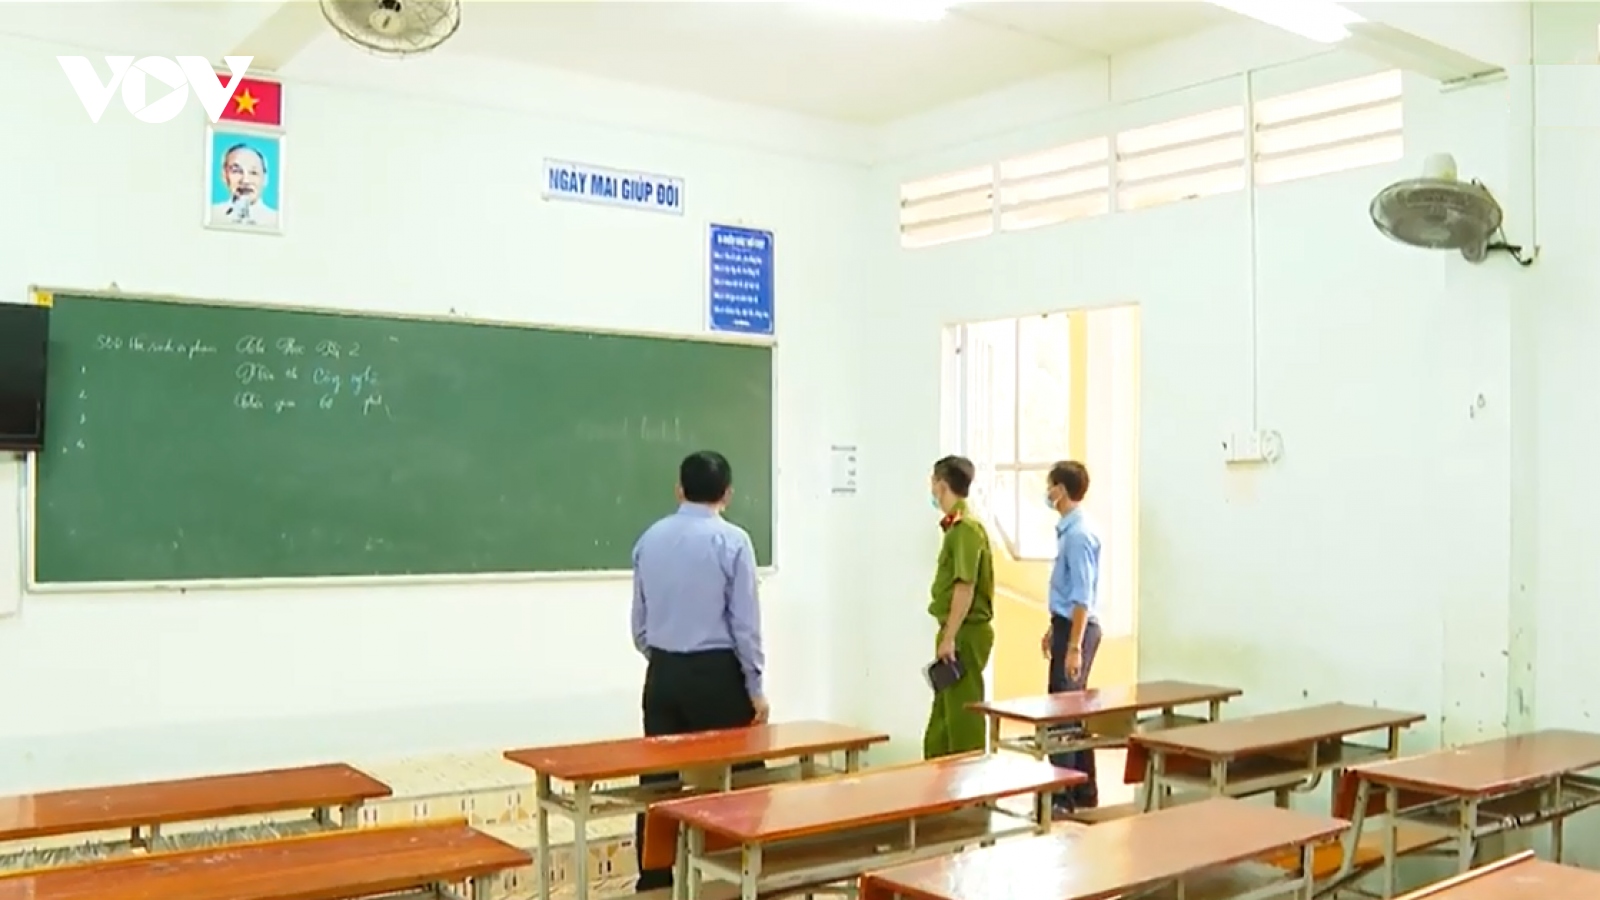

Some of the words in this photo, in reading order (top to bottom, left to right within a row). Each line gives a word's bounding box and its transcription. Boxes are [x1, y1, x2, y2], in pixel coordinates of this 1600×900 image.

[549, 165, 587, 194] NGÀY
[591, 174, 617, 198] MAI
[622, 175, 653, 202] GIÚP
[349, 341, 361, 356] 2
